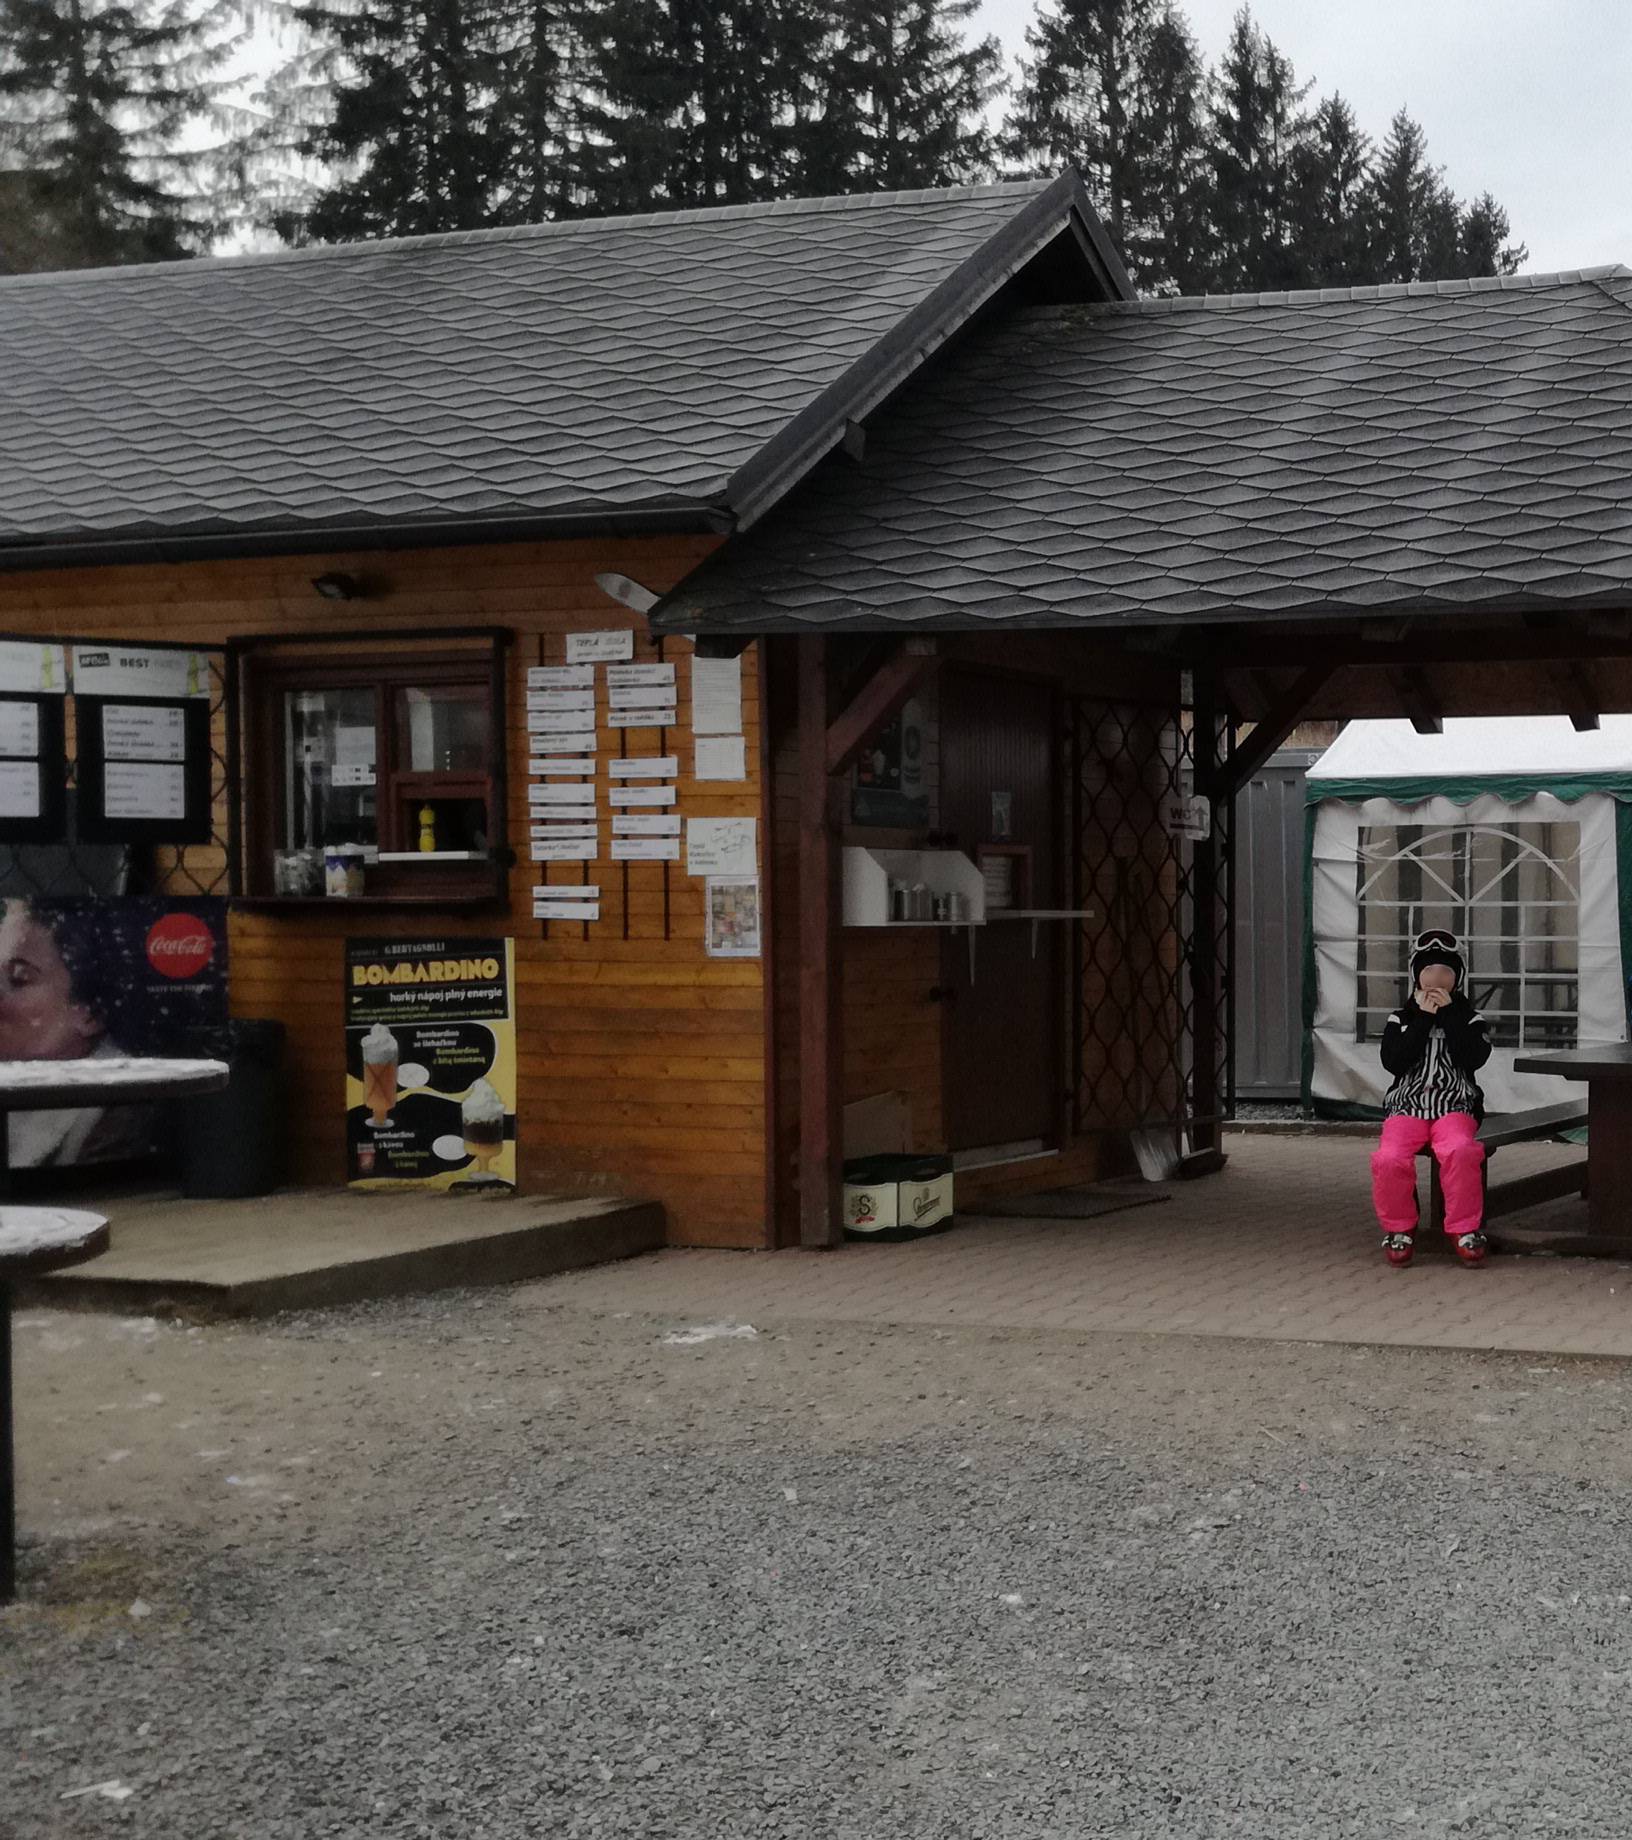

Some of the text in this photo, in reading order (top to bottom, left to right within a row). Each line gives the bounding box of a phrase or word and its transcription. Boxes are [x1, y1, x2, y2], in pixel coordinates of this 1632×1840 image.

[119, 657, 150, 669] BEST
[1170, 807, 1192, 820] WC
[150, 935, 207, 956] Coca-Cola
[352, 958, 500, 986] BOMBARDINO
[390, 987, 503, 1003] horký nápoj plný energie
[416, 1030, 460, 1039] Bombardino
[373, 1131, 415, 1140] Bombardino
